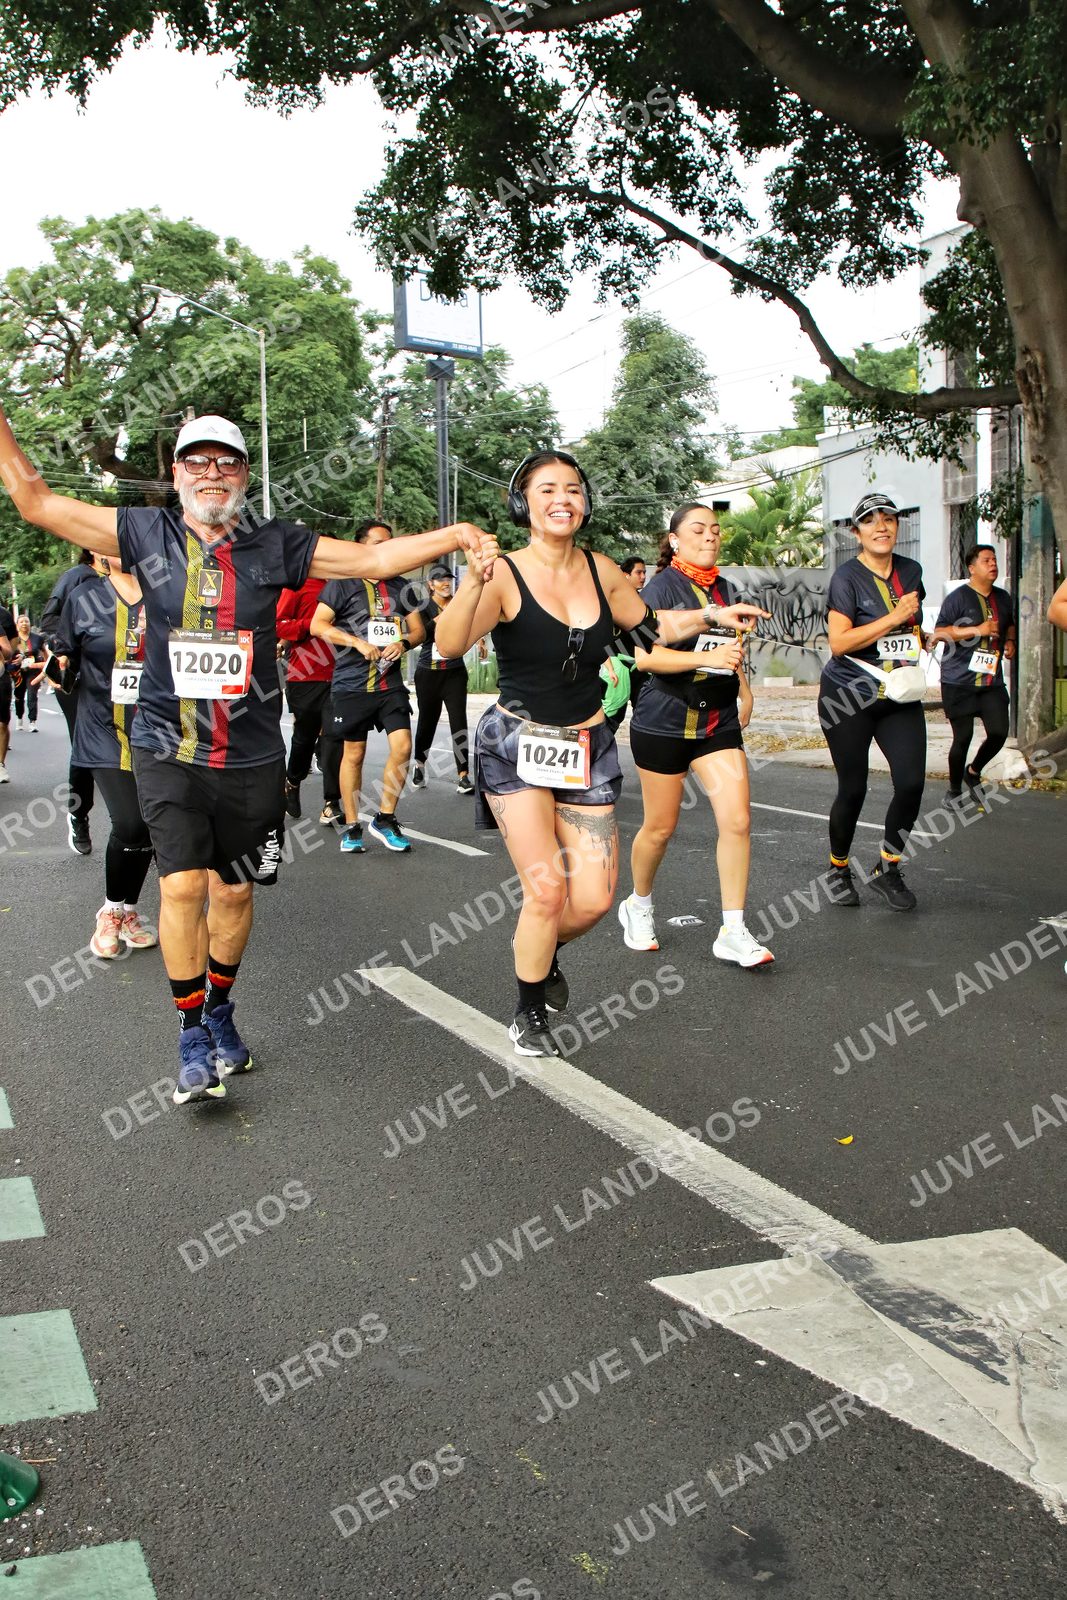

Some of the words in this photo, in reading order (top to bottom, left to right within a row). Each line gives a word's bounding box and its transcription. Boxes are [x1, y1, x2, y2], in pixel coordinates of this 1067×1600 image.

[373, 626, 395, 636] 6346
[883, 638, 913, 653] 3972
[173, 651, 242, 675] 12020
[976, 655, 993, 665] 7143
[120, 675, 138, 690] 42
[523, 743, 579, 768] 10241
